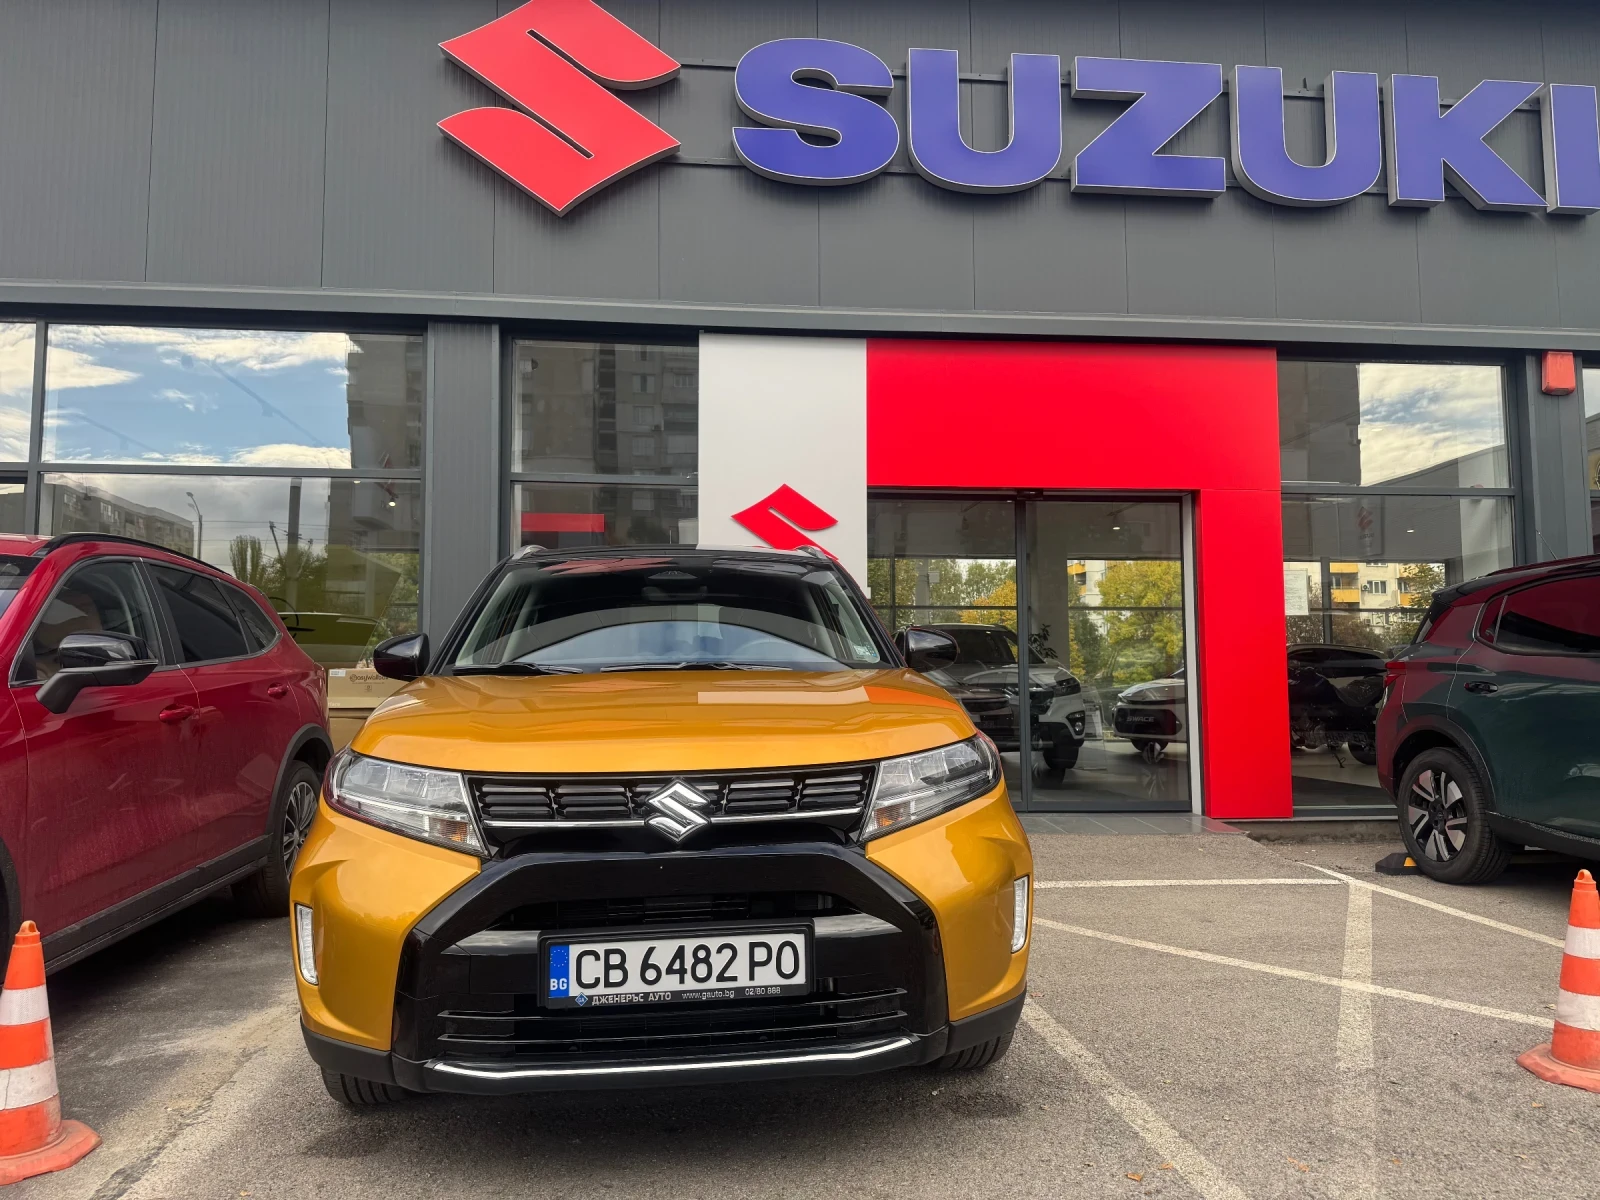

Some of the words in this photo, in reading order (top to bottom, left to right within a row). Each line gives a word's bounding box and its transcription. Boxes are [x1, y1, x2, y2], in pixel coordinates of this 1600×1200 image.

[732, 38, 1600, 215] SUZUKI
[1126, 715, 1155, 723] SWACE
[575, 948, 629, 989] CB
[640, 942, 739, 986] 6482
[550, 978, 568, 991] BG
[648, 992, 672, 1001] АУТО
[682, 989, 735, 1000] www.gauto.bg
